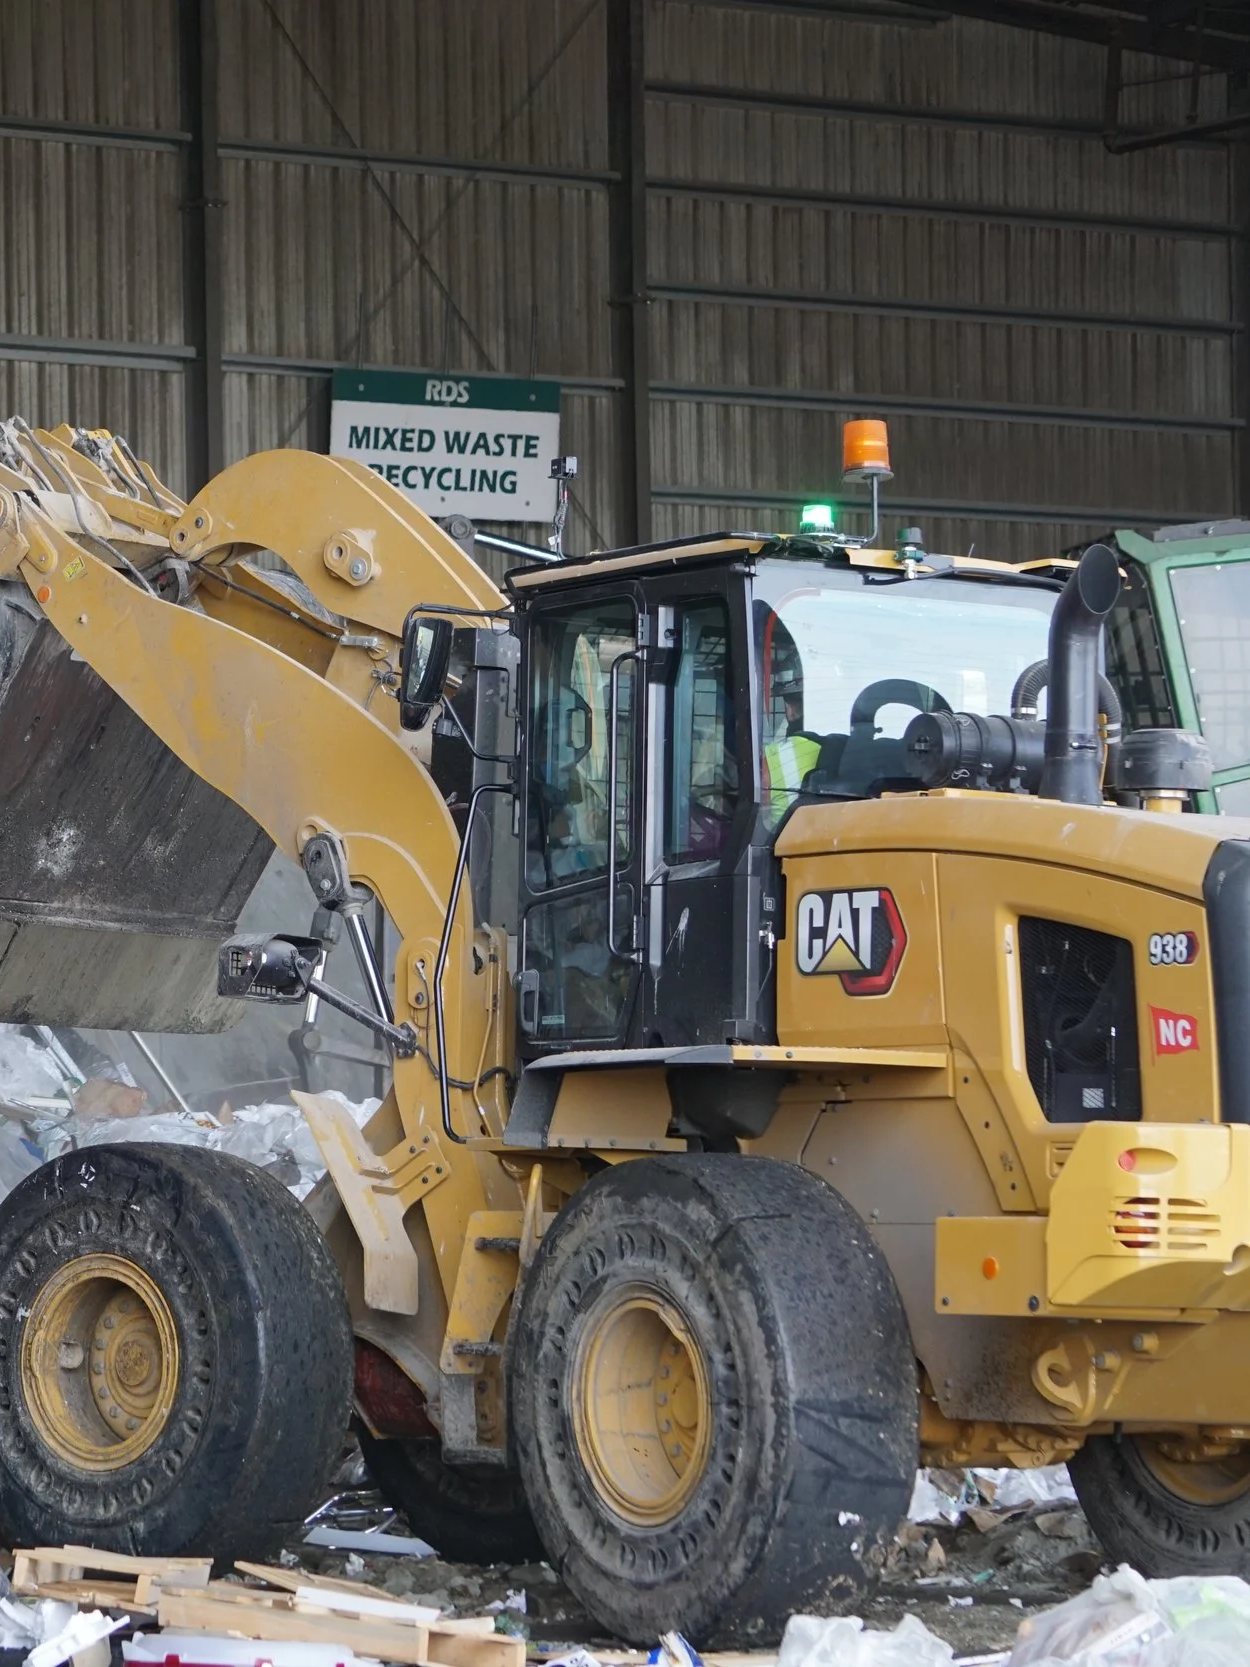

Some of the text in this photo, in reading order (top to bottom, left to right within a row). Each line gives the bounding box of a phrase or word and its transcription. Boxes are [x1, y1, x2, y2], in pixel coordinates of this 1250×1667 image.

[425, 379, 470, 404] RDS
[348, 425, 540, 459] MIXED WASTE
[798, 891, 879, 973] CAT
[1150, 933, 1188, 965] 938
[1158, 1018, 1193, 1048] NC
